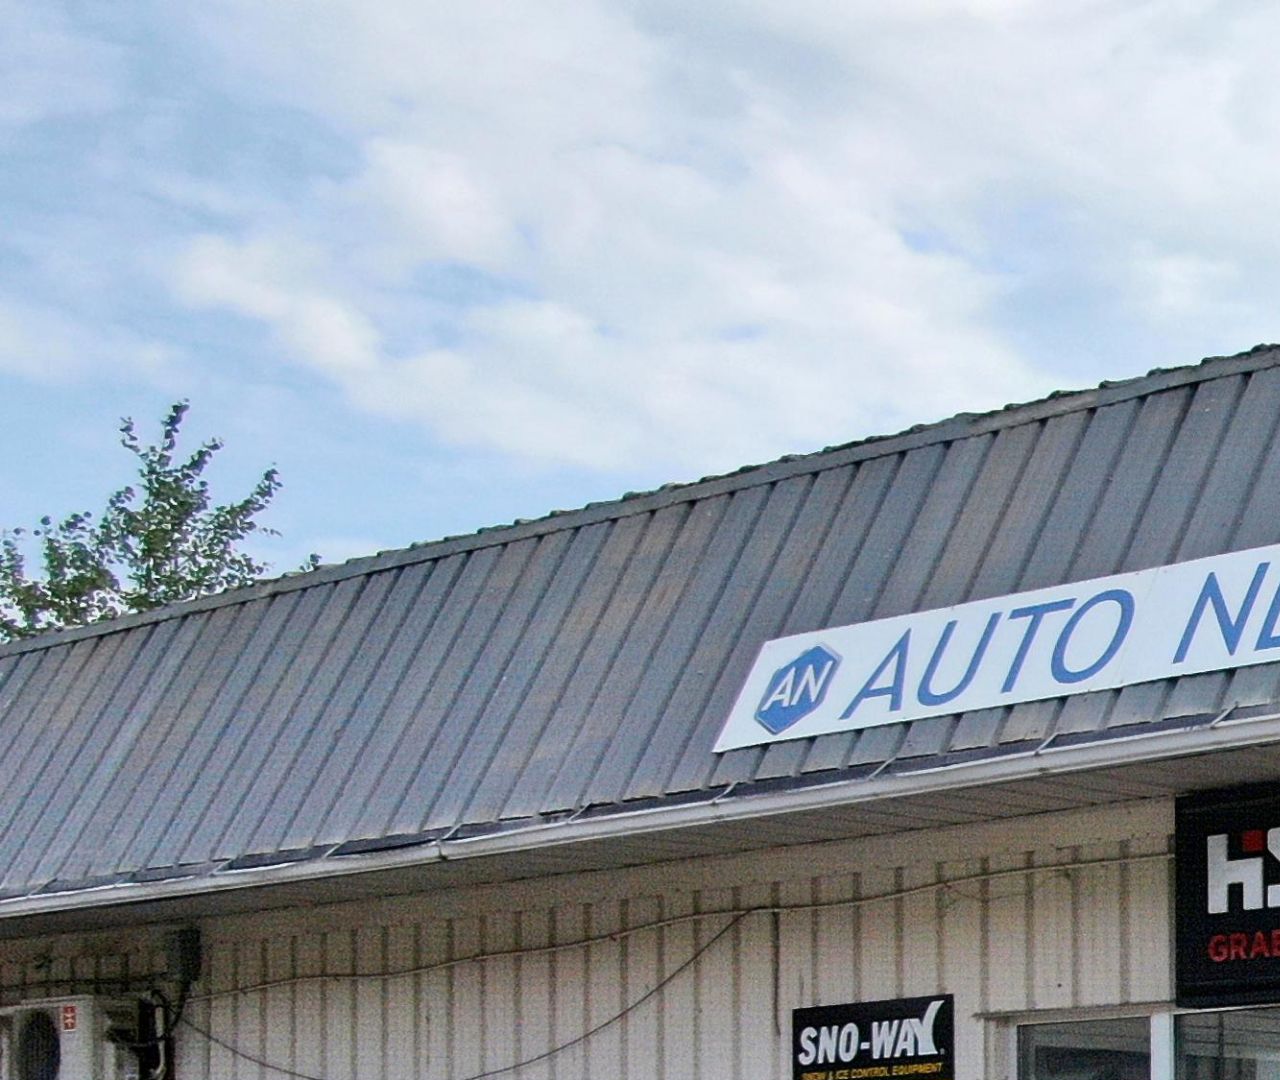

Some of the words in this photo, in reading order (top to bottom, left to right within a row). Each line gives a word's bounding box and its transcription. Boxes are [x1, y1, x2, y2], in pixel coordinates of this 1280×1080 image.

[761, 660, 830, 711] AN
[839, 589, 1135, 720] AUTO
[798, 1000, 945, 1066] SNO-WAY
[835, 1070, 849, 1080] ICE
[851, 1067, 890, 1079] CONTROL
[892, 1063, 944, 1076] EQUIPMENT
